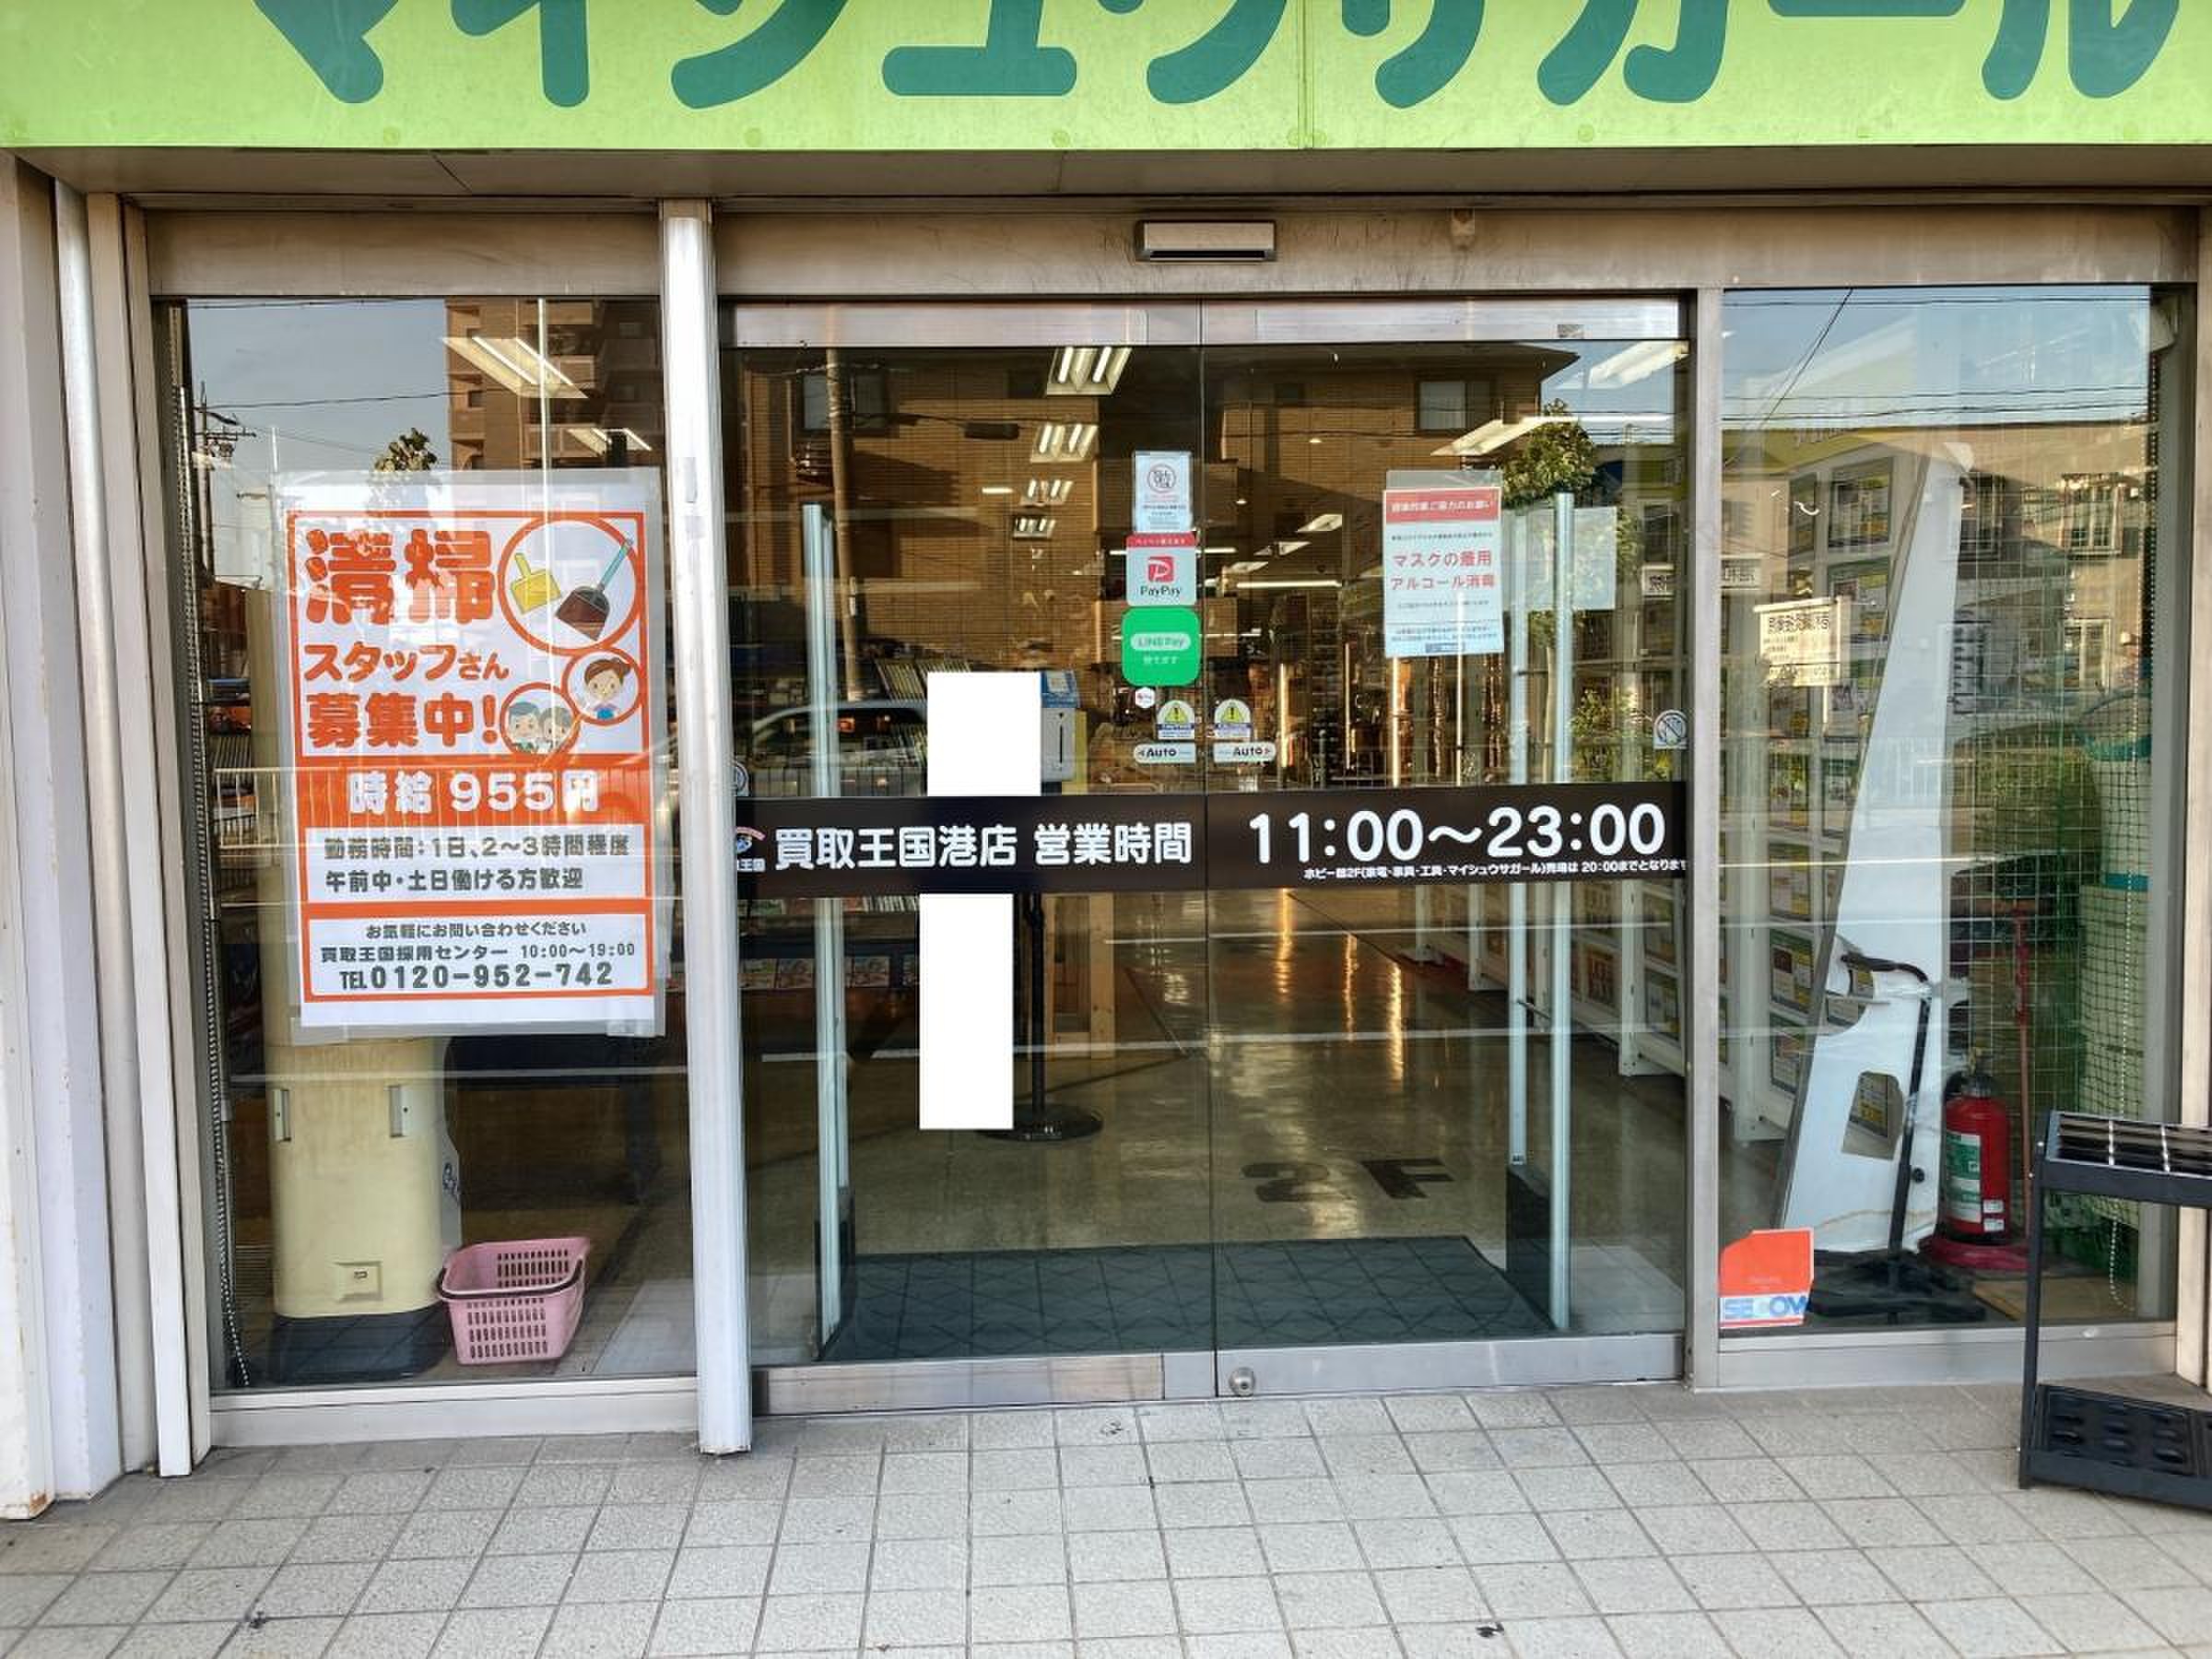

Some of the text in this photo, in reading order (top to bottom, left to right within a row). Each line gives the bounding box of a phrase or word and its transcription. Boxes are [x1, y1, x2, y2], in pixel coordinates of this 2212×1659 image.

[1393, 549, 1492, 569] マスクの着用
[306, 528, 495, 626] 清掃
[1390, 574, 1495, 591] アルコール消毒
[1140, 585, 1182, 597] PayPay
[304, 641, 510, 682] スタッフさん
[1147, 747, 1177, 758] Auto
[1232, 746, 1263, 757] Auto
[774, 821, 1194, 870] 買取王国港店 営業時間
[325, 867, 583, 893] 午前中・土日働ける方歓迎
[366, 922, 587, 940] お気軽にお問い合わせください
[320, 946, 508, 964] 買取王国採用センター
